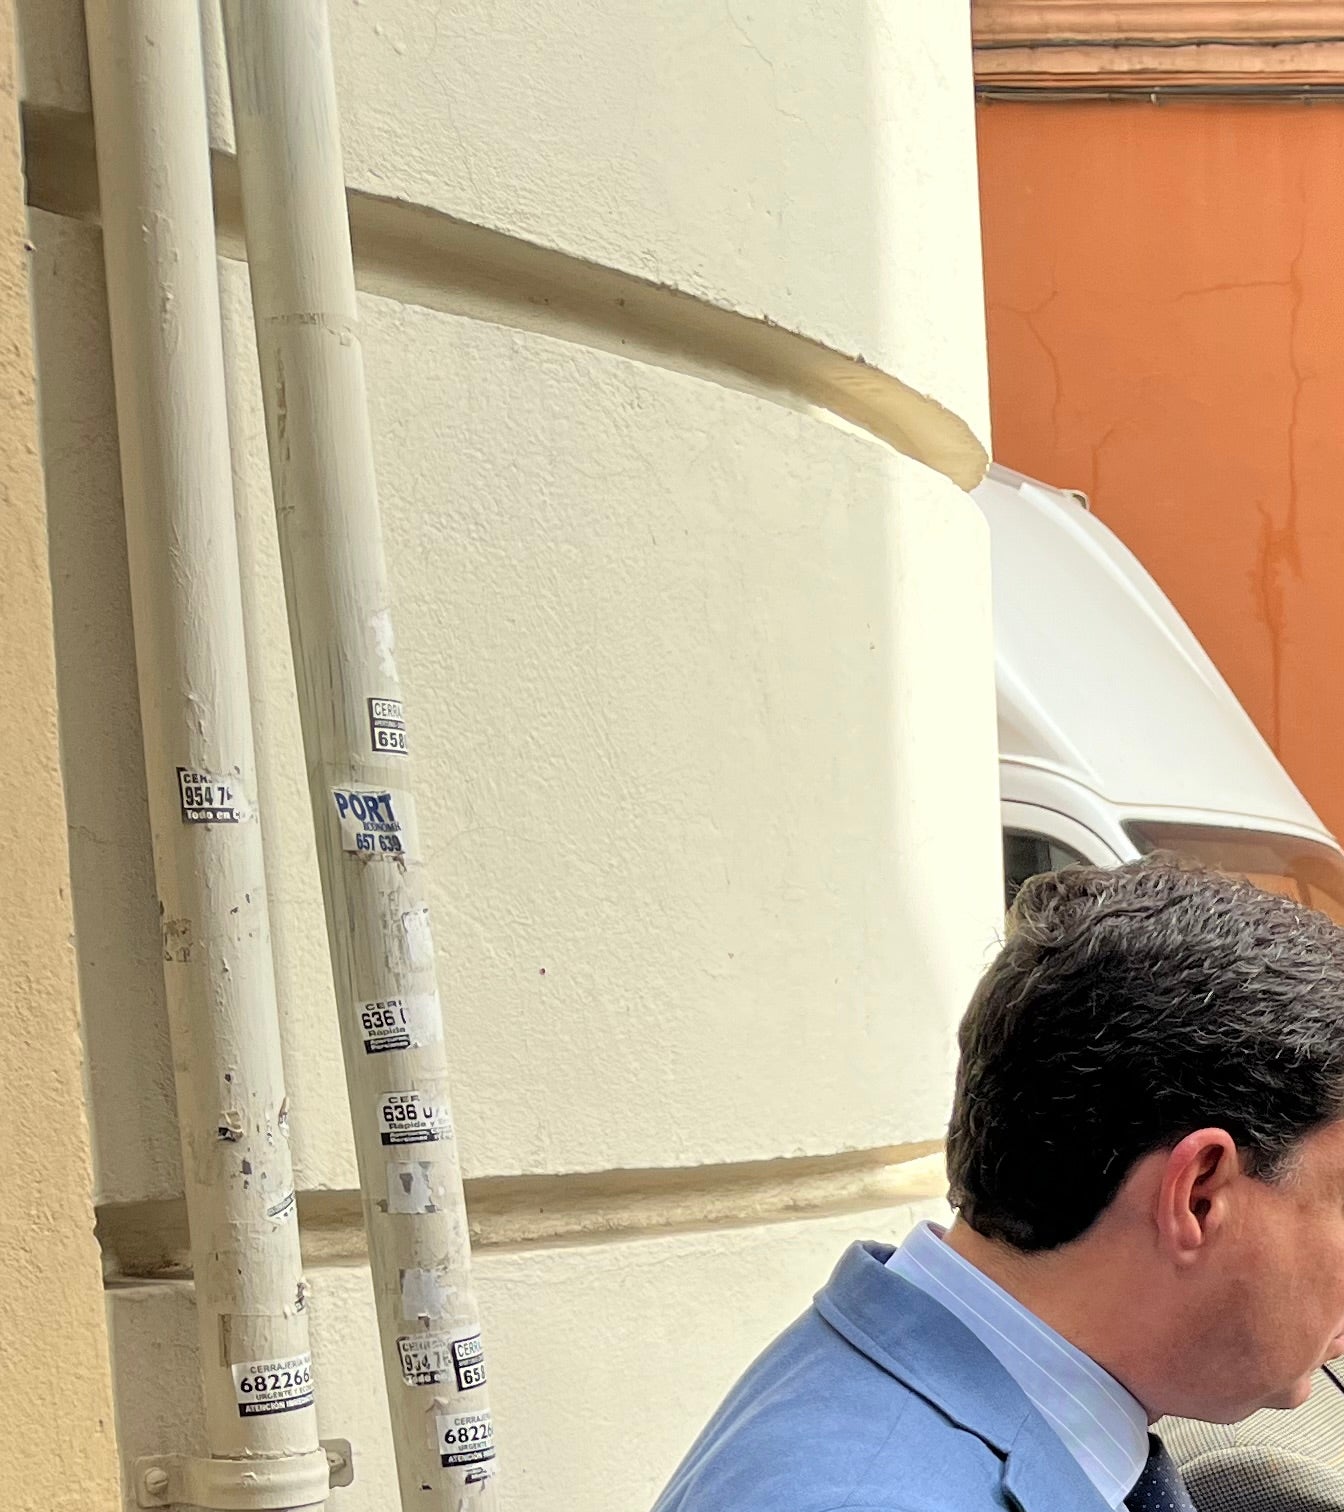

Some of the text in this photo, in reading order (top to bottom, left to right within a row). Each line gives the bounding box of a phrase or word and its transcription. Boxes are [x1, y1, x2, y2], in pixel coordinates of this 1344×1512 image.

[185, 786, 213, 806] 954
[334, 791, 395, 823] PORT
[361, 1010, 395, 1029] 636
[383, 1104, 417, 1122] 636
